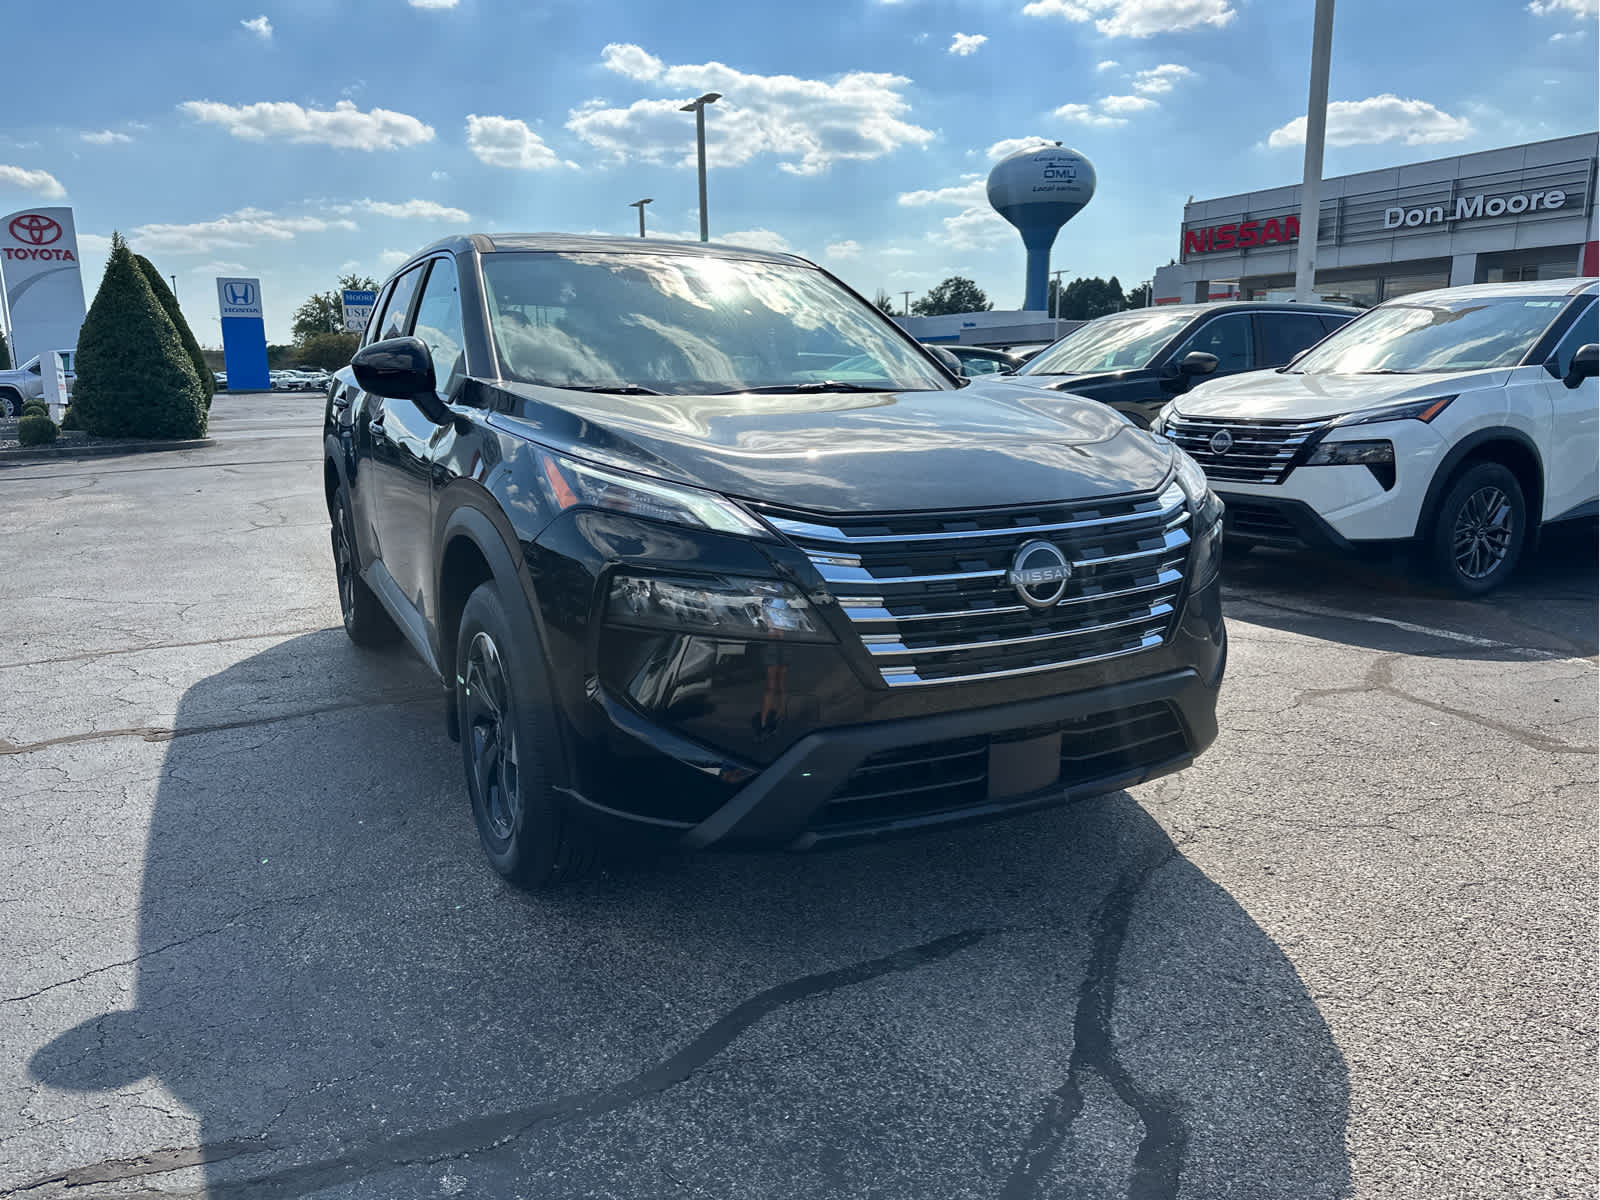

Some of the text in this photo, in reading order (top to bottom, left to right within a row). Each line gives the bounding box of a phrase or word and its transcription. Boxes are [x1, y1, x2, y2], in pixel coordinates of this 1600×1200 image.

[1384, 189, 1567, 229] Don Moore
[1184, 215, 1301, 255] NISSAN
[2, 247, 76, 261] TOYOTA
[346, 308, 371, 317] USE
[347, 320, 367, 330] CA
[1010, 565, 1072, 584] NISSAN
